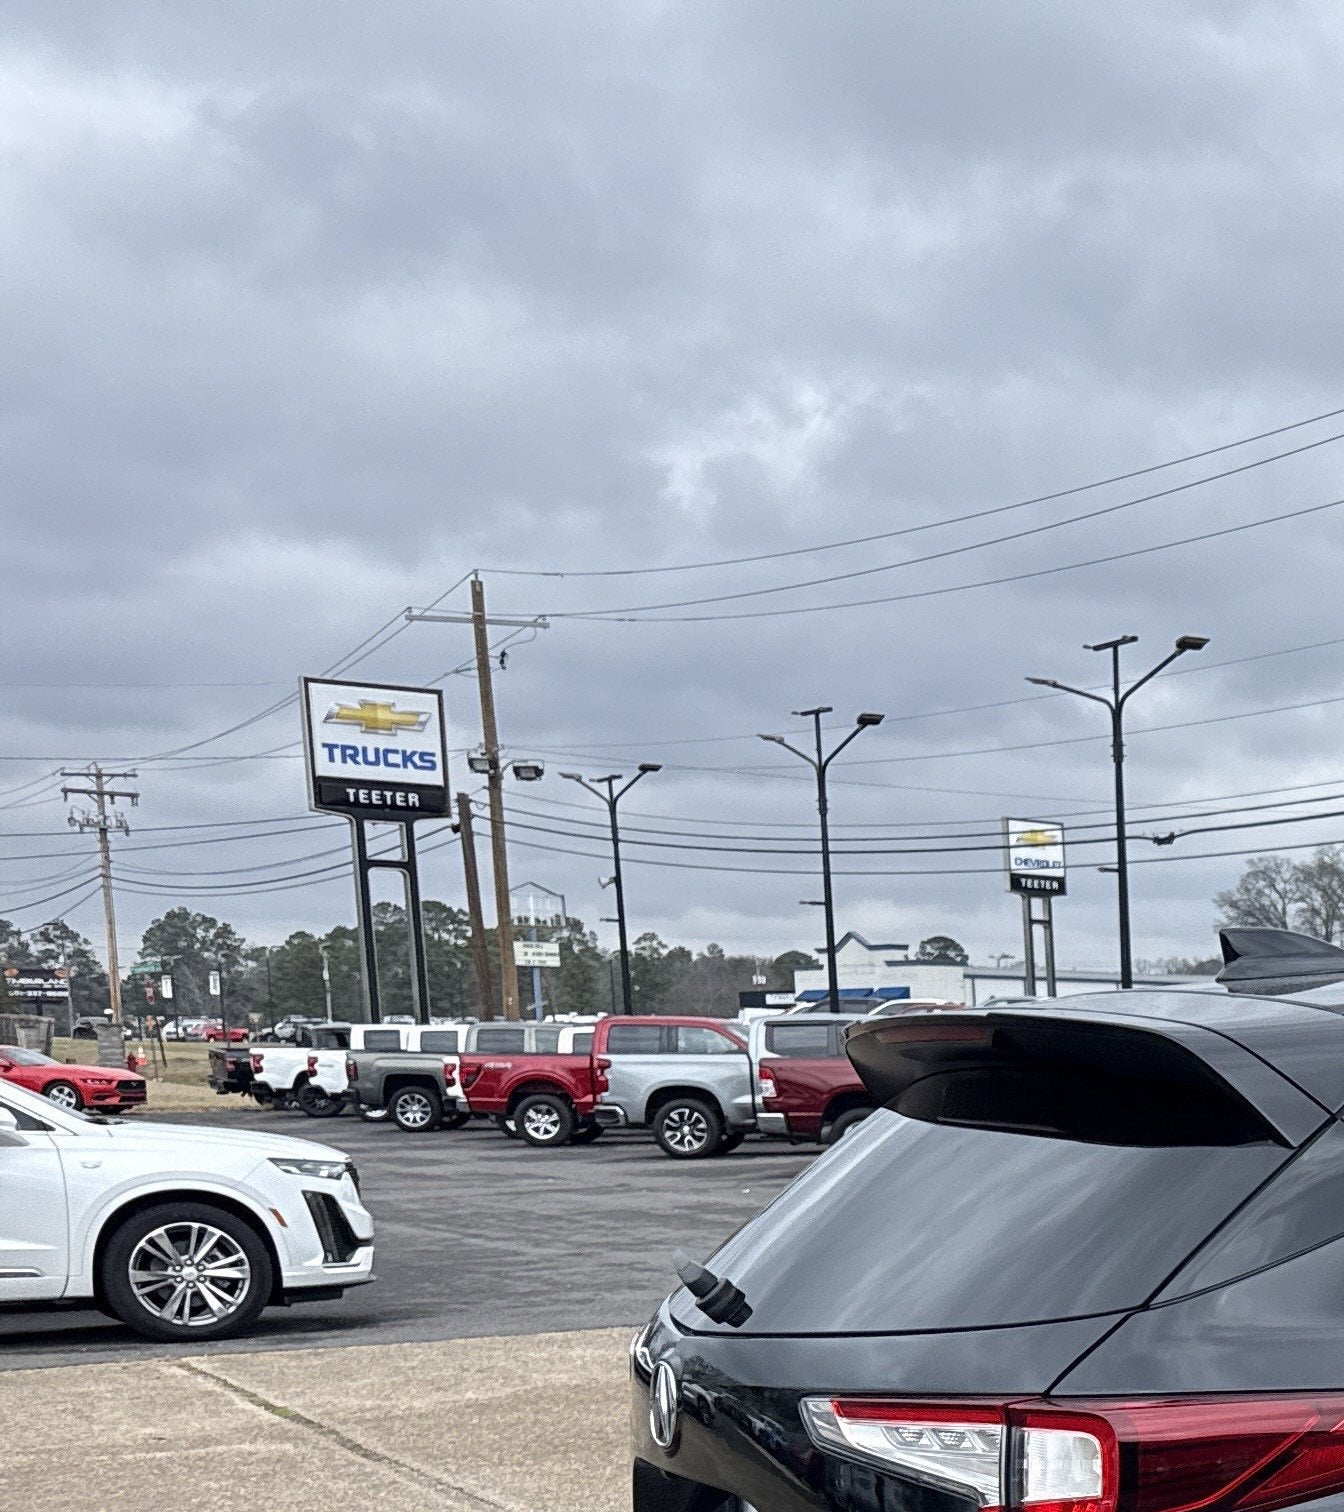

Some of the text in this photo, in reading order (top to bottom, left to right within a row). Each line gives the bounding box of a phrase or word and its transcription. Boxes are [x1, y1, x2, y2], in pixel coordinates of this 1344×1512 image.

[321, 742, 437, 771] TRUCKS
[346, 788, 420, 807] TEETER
[1020, 878, 1059, 890] TEETER
